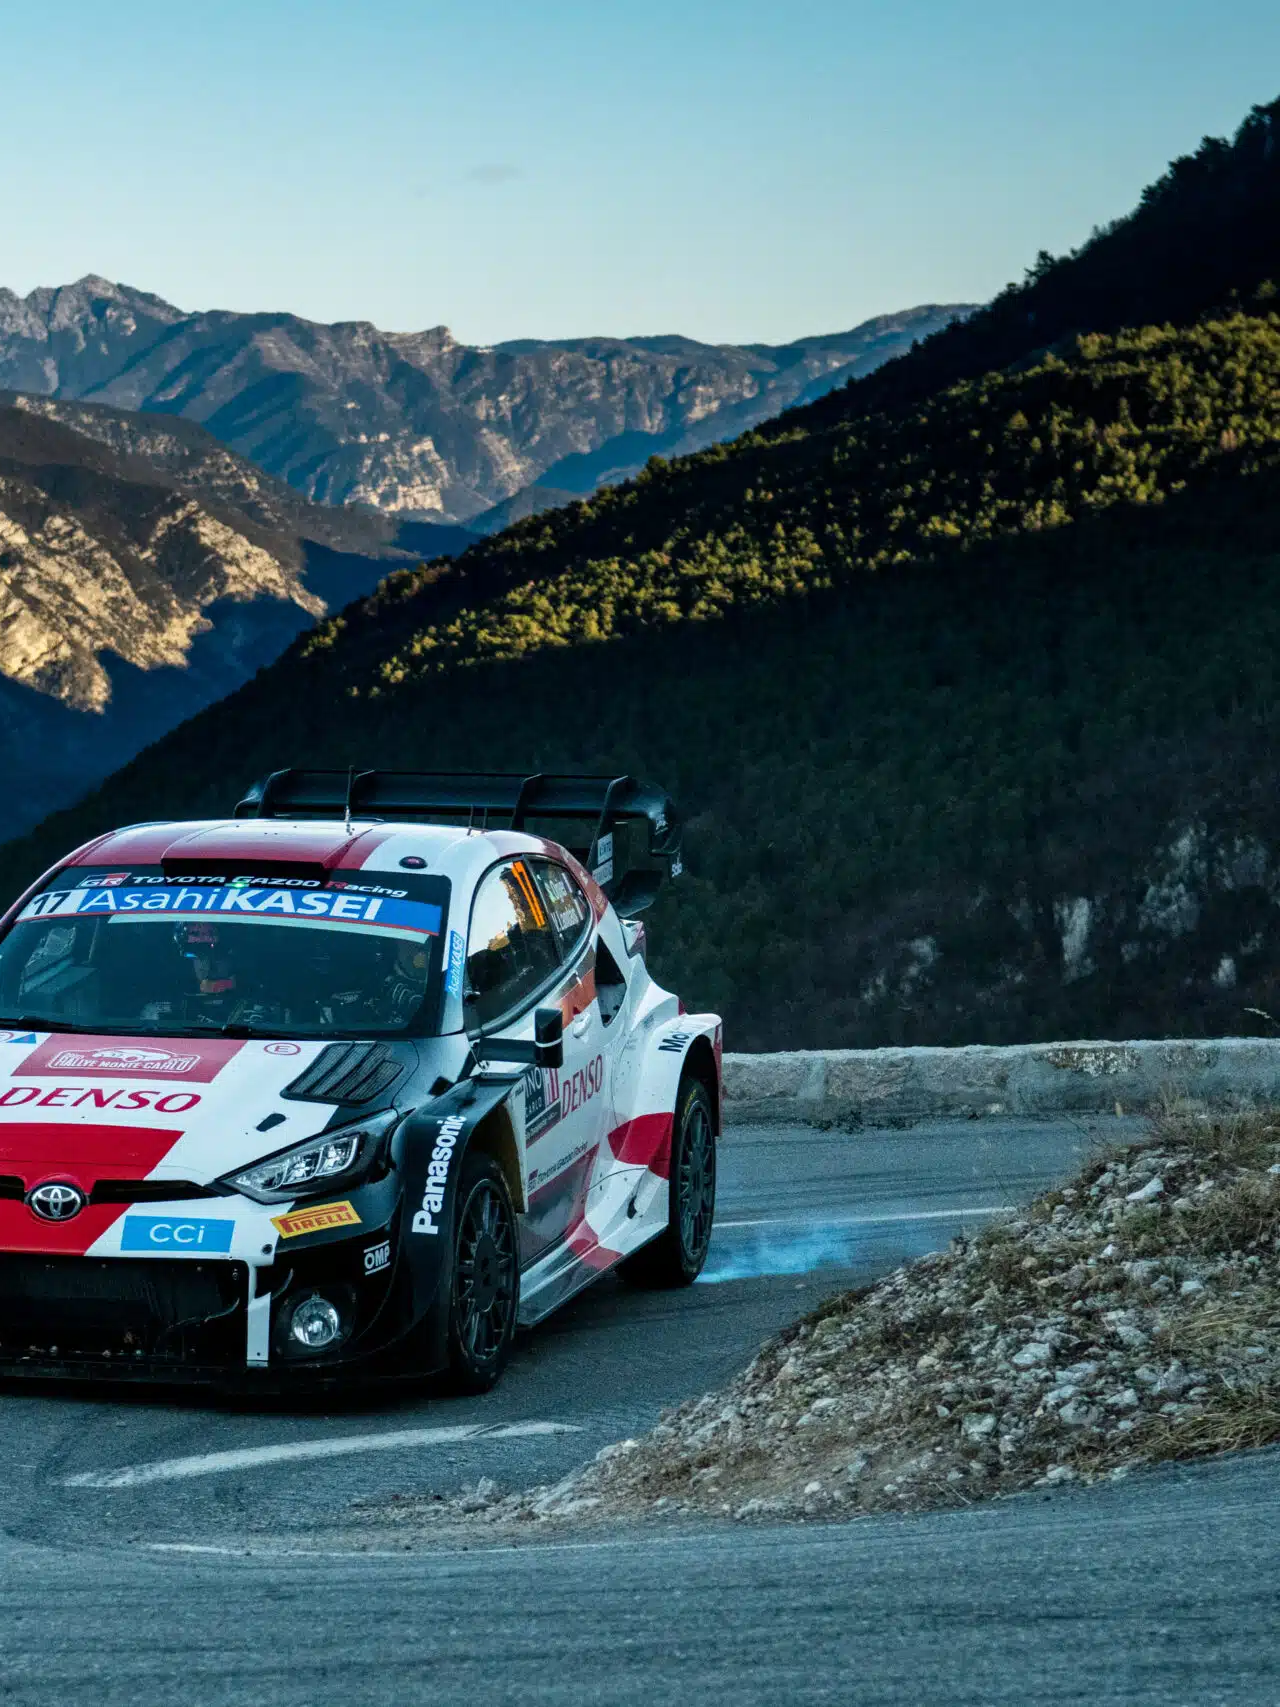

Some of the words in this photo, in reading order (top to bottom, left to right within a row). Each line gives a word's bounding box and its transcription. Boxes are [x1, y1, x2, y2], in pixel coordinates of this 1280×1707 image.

[81, 876, 124, 888] GR
[132, 876, 226, 884] TOYOTA
[232, 875, 321, 887] GAZOO
[324, 881, 409, 898] Racing
[33, 891, 72, 915] 17
[562, 1054, 603, 1120] DENSO
[412, 1115, 467, 1235] Panasonic
[278, 1205, 354, 1233] PIRELLI
[364, 1245, 390, 1270] OMP
